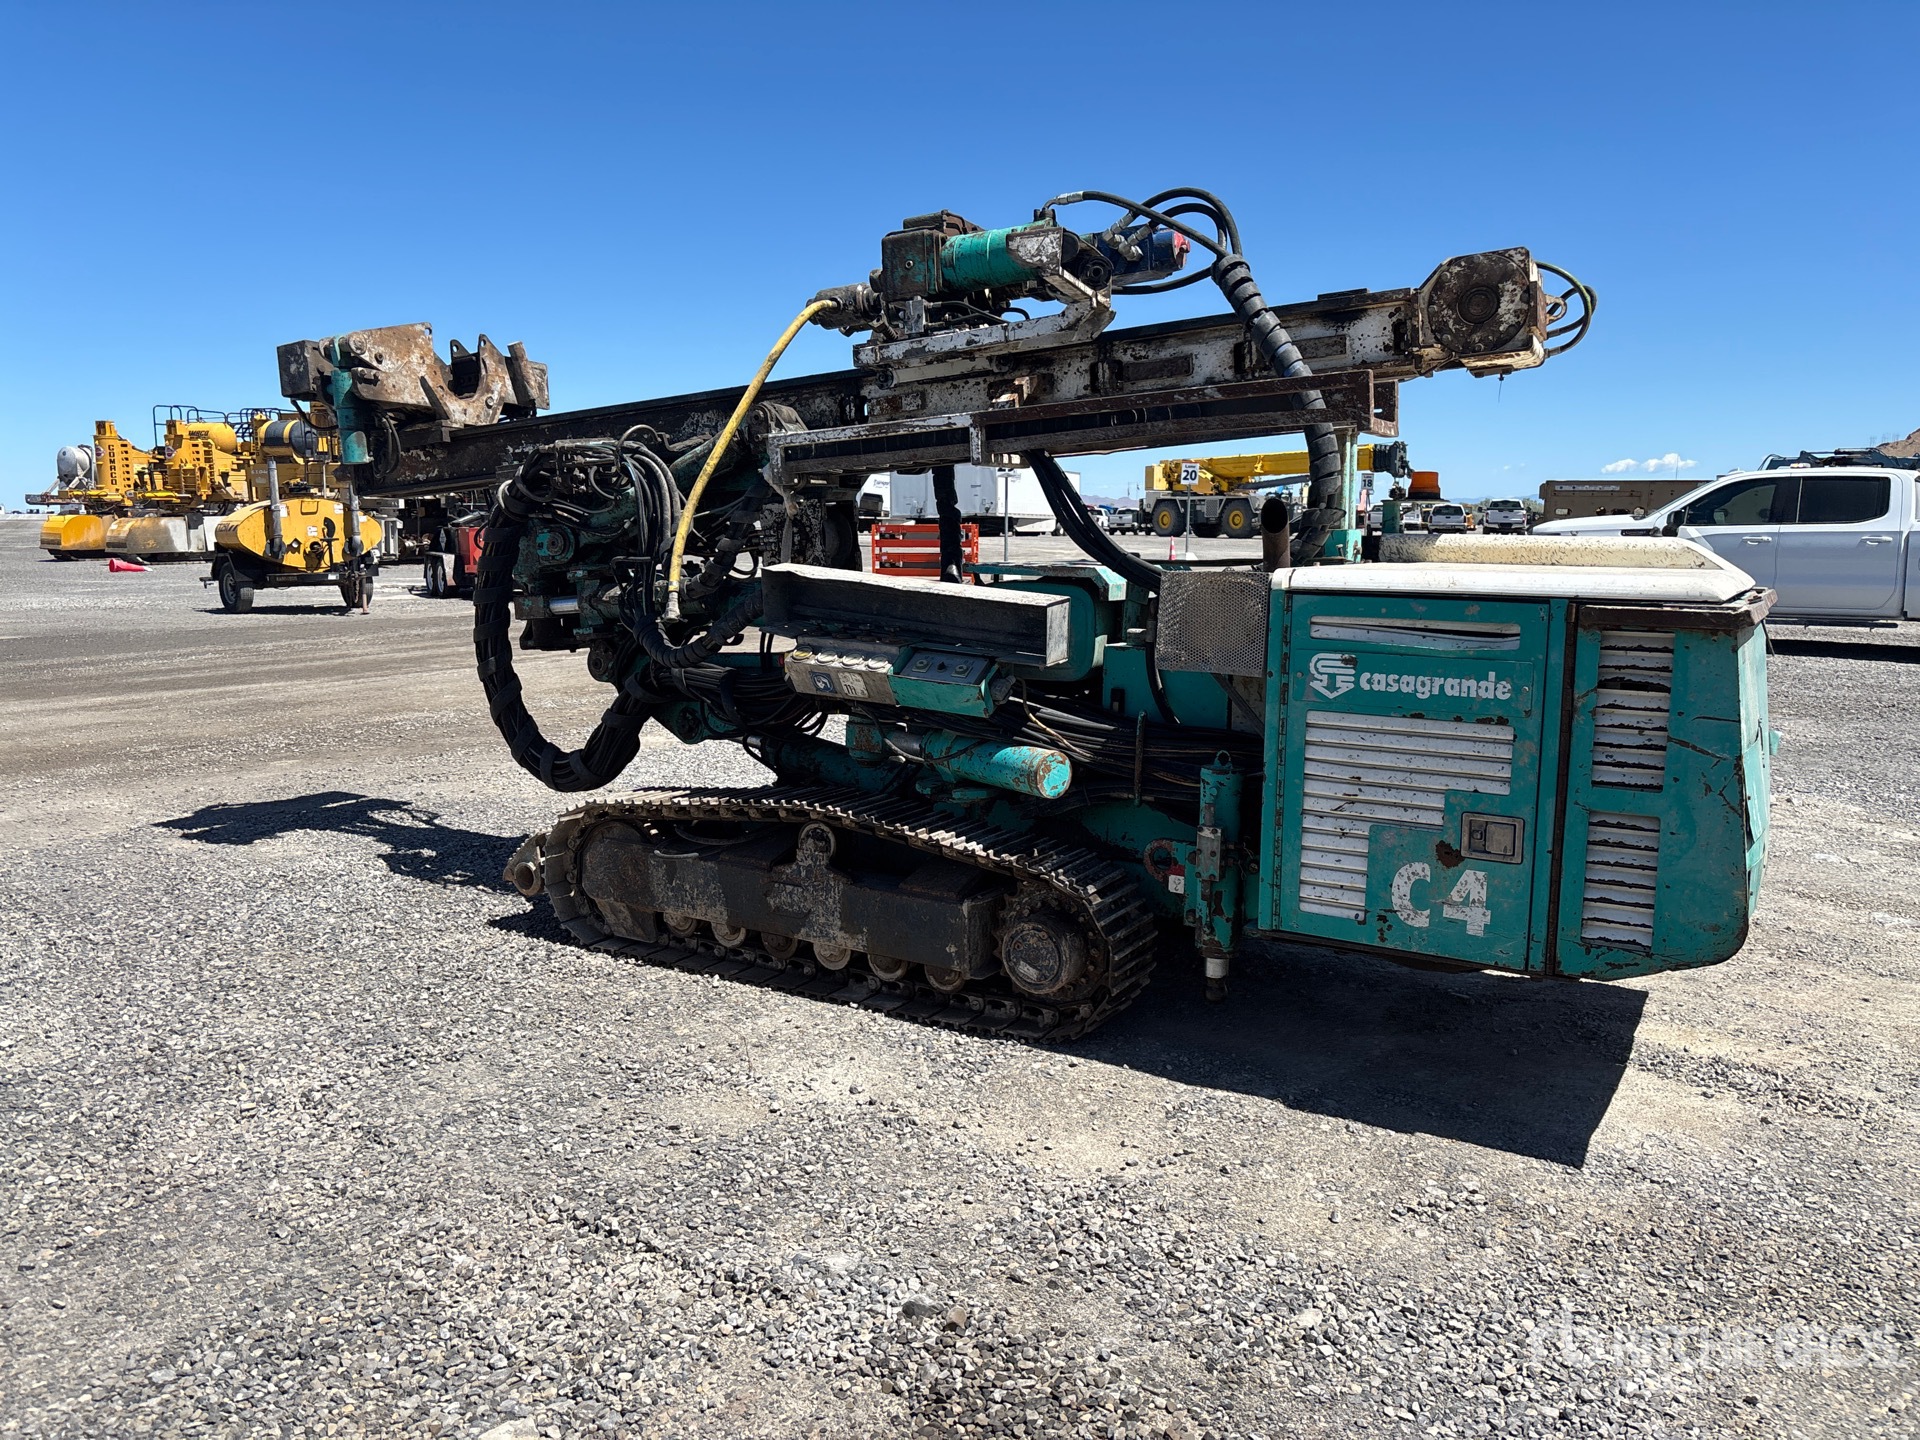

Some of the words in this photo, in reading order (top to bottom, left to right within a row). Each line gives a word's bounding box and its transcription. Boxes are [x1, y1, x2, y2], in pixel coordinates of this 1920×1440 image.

[1182, 469, 1197, 481] 20
[1362, 479, 1373, 488] 18
[1359, 671, 1512, 701] casagrande
